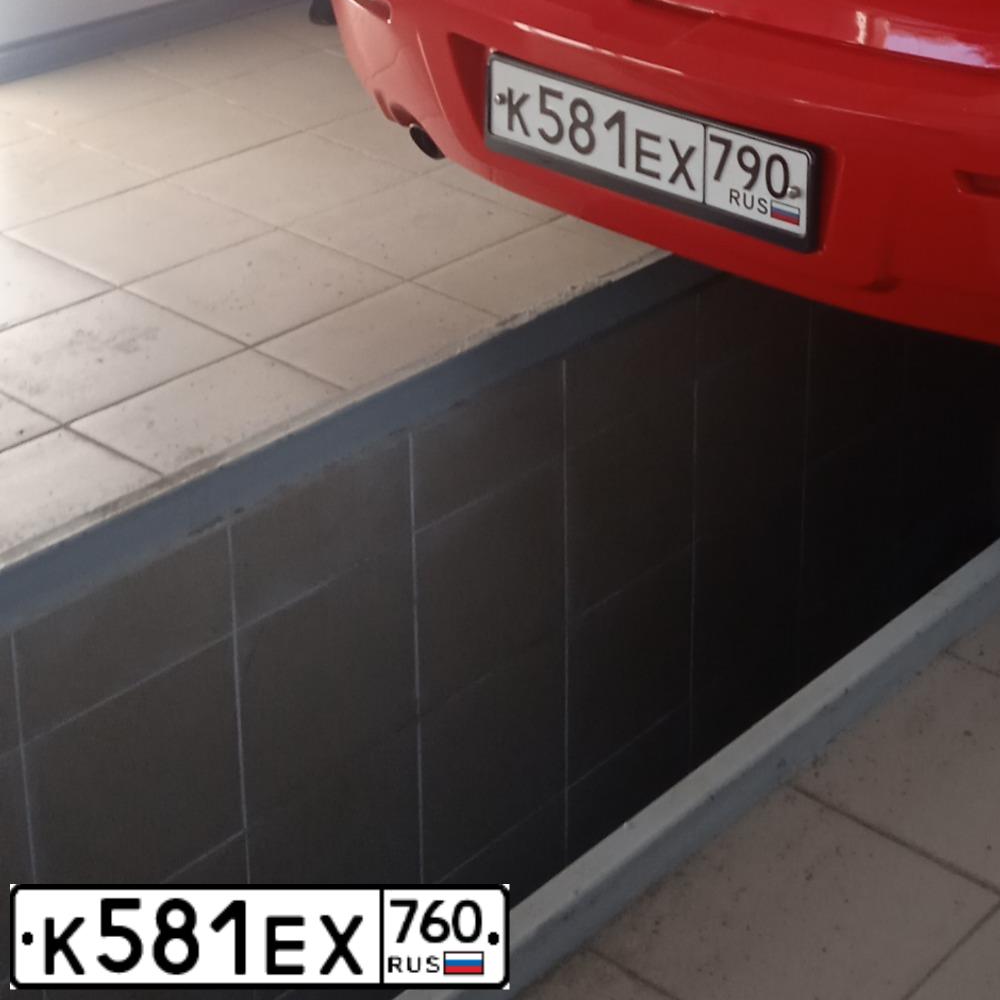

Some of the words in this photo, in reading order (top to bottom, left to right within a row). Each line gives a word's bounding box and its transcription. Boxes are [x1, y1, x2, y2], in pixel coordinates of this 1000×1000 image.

[506, 86, 696, 191] K581EX
[709, 134, 790, 199] 790
[728, 188, 768, 215] RUS
